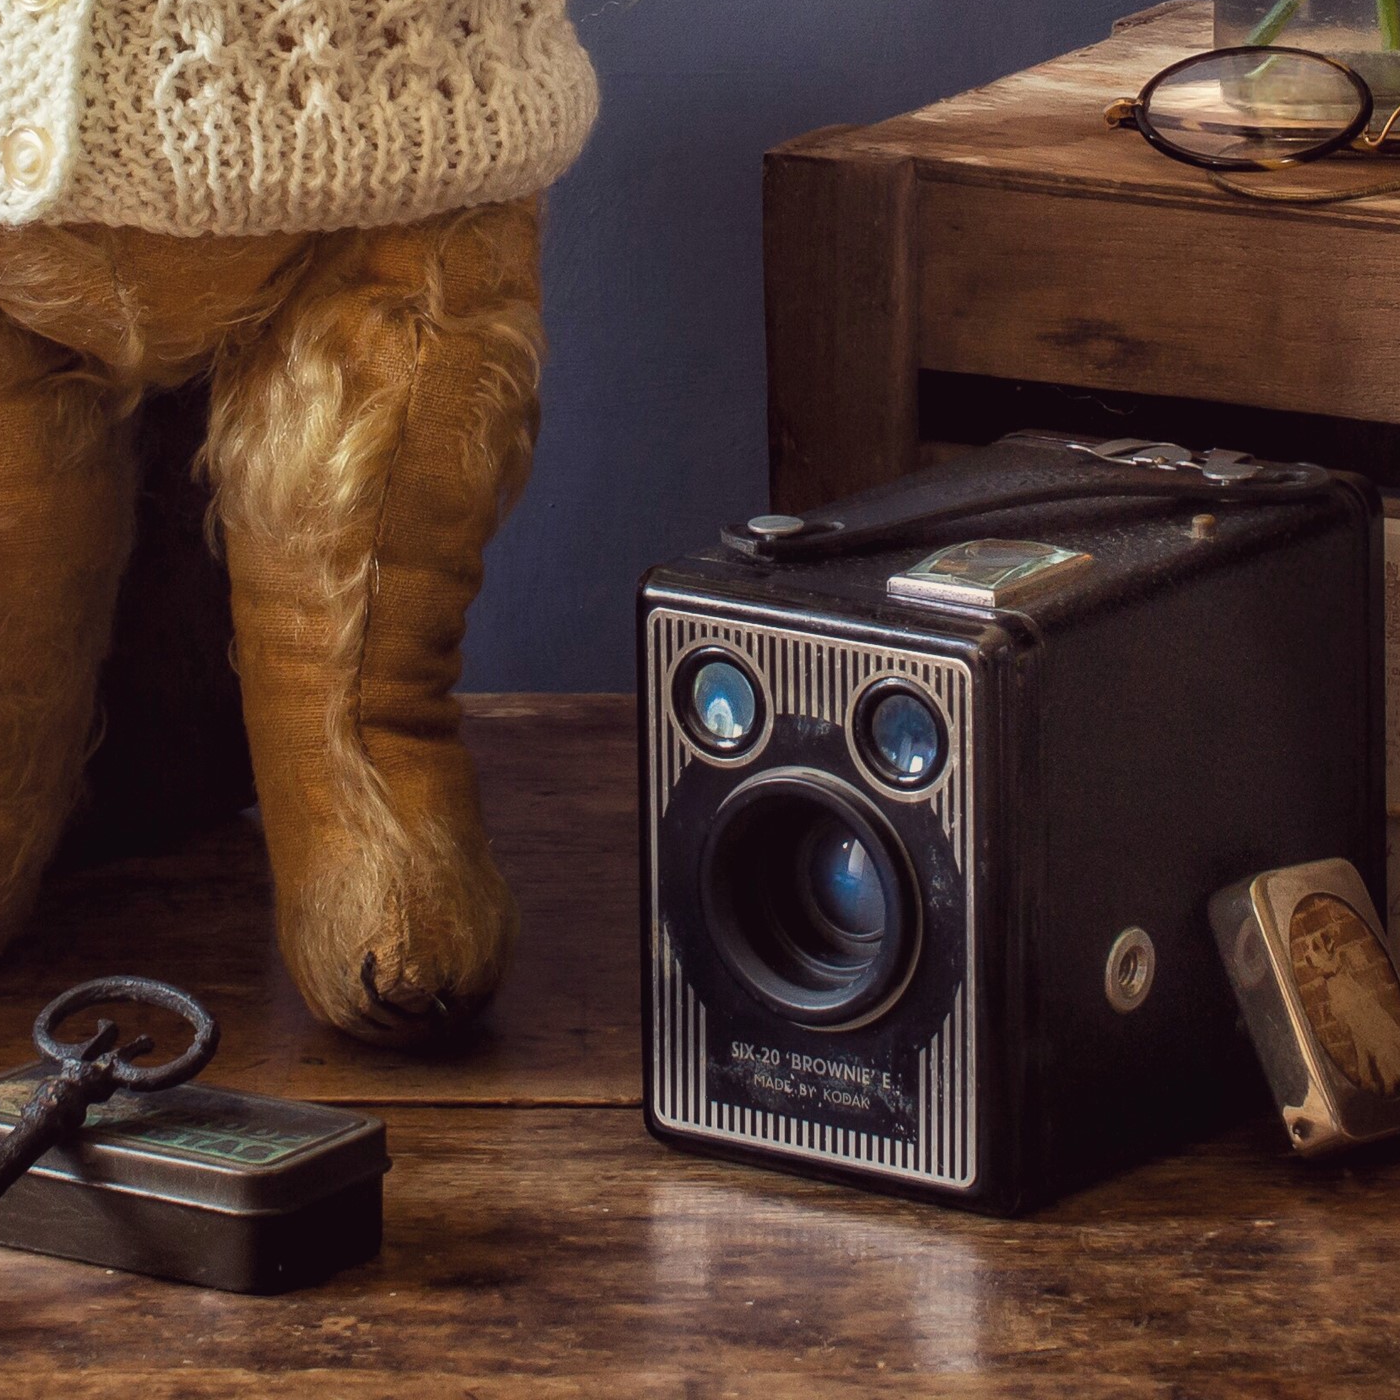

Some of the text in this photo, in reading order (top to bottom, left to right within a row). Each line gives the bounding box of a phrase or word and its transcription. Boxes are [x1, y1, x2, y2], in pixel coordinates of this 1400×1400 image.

[731, 1041, 780, 1066] SIX-20
[753, 1074, 871, 1110] MADE BY KODAK
